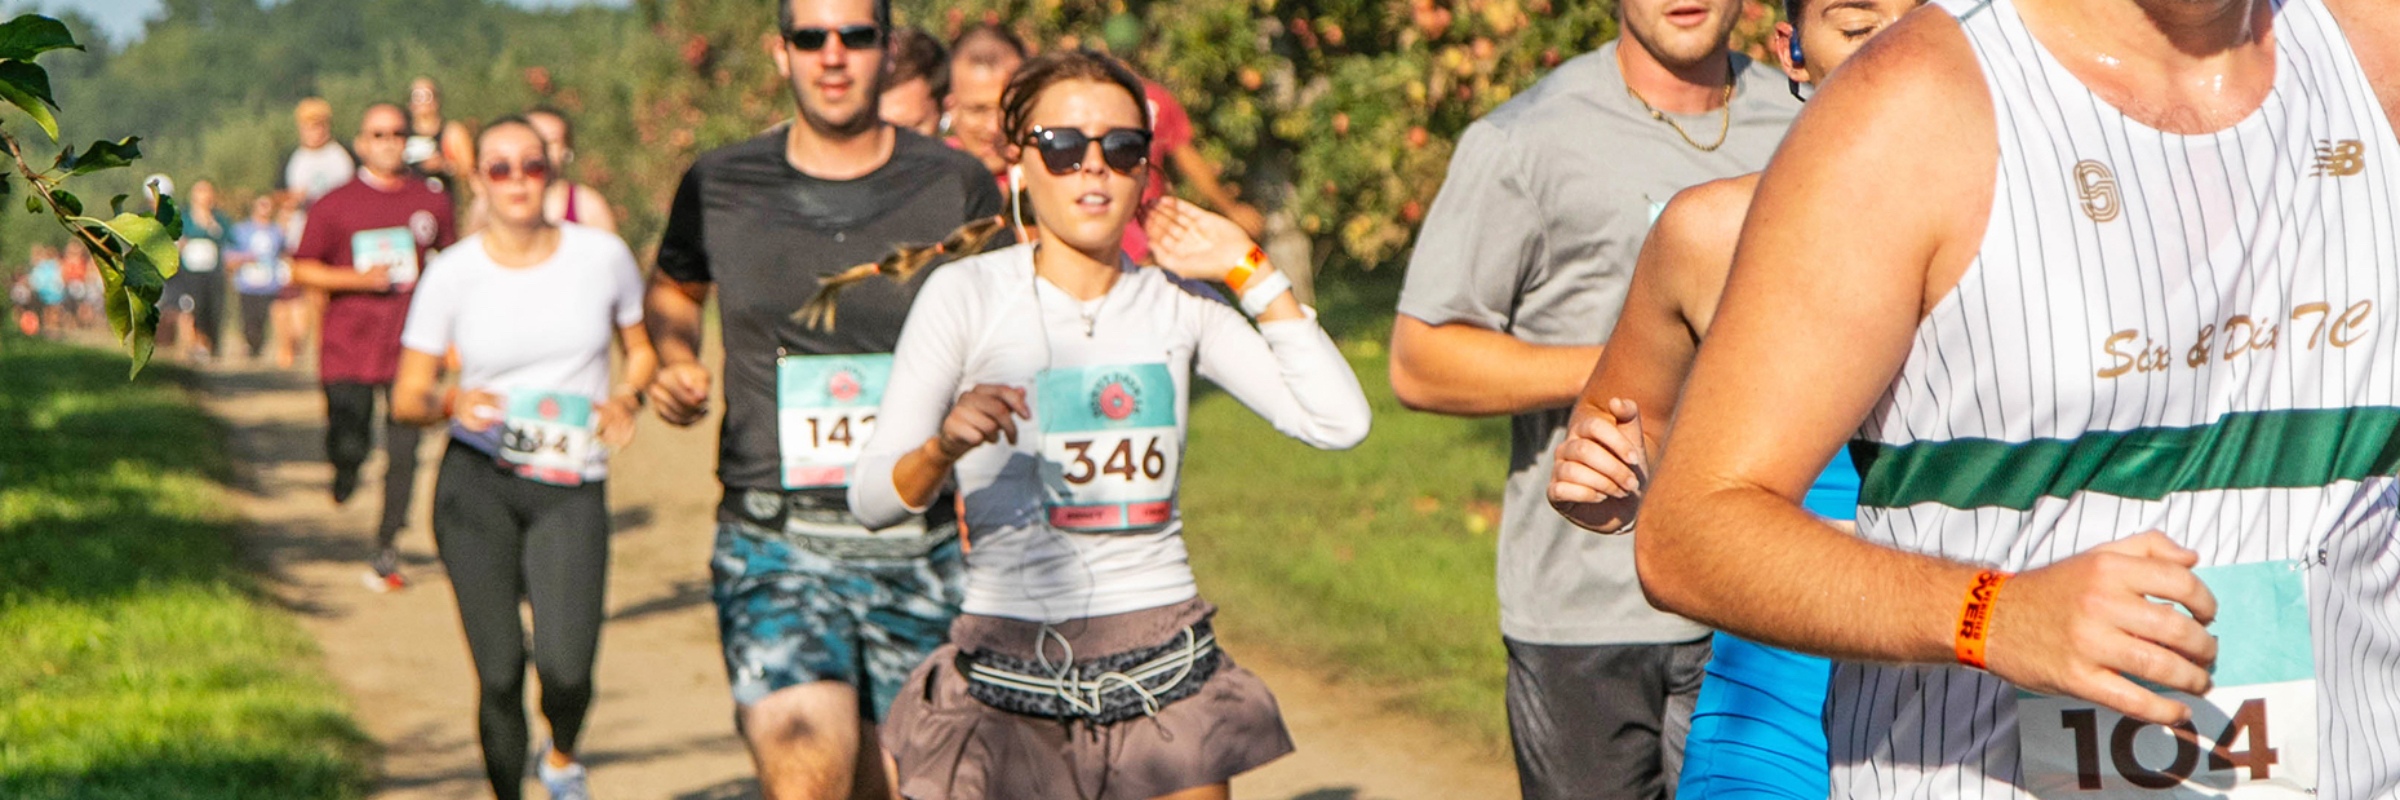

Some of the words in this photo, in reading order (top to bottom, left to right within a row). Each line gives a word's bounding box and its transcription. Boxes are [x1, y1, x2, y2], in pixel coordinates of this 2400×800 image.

[2097, 329, 2172, 378] Six
[2187, 323, 2215, 368] &
[2291, 299, 2372, 352] TC
[805, 414, 876, 448] 14
[1063, 436, 1165, 485] 346
[1960, 571, 1993, 638] OVER
[2060, 697, 2278, 790] 104
